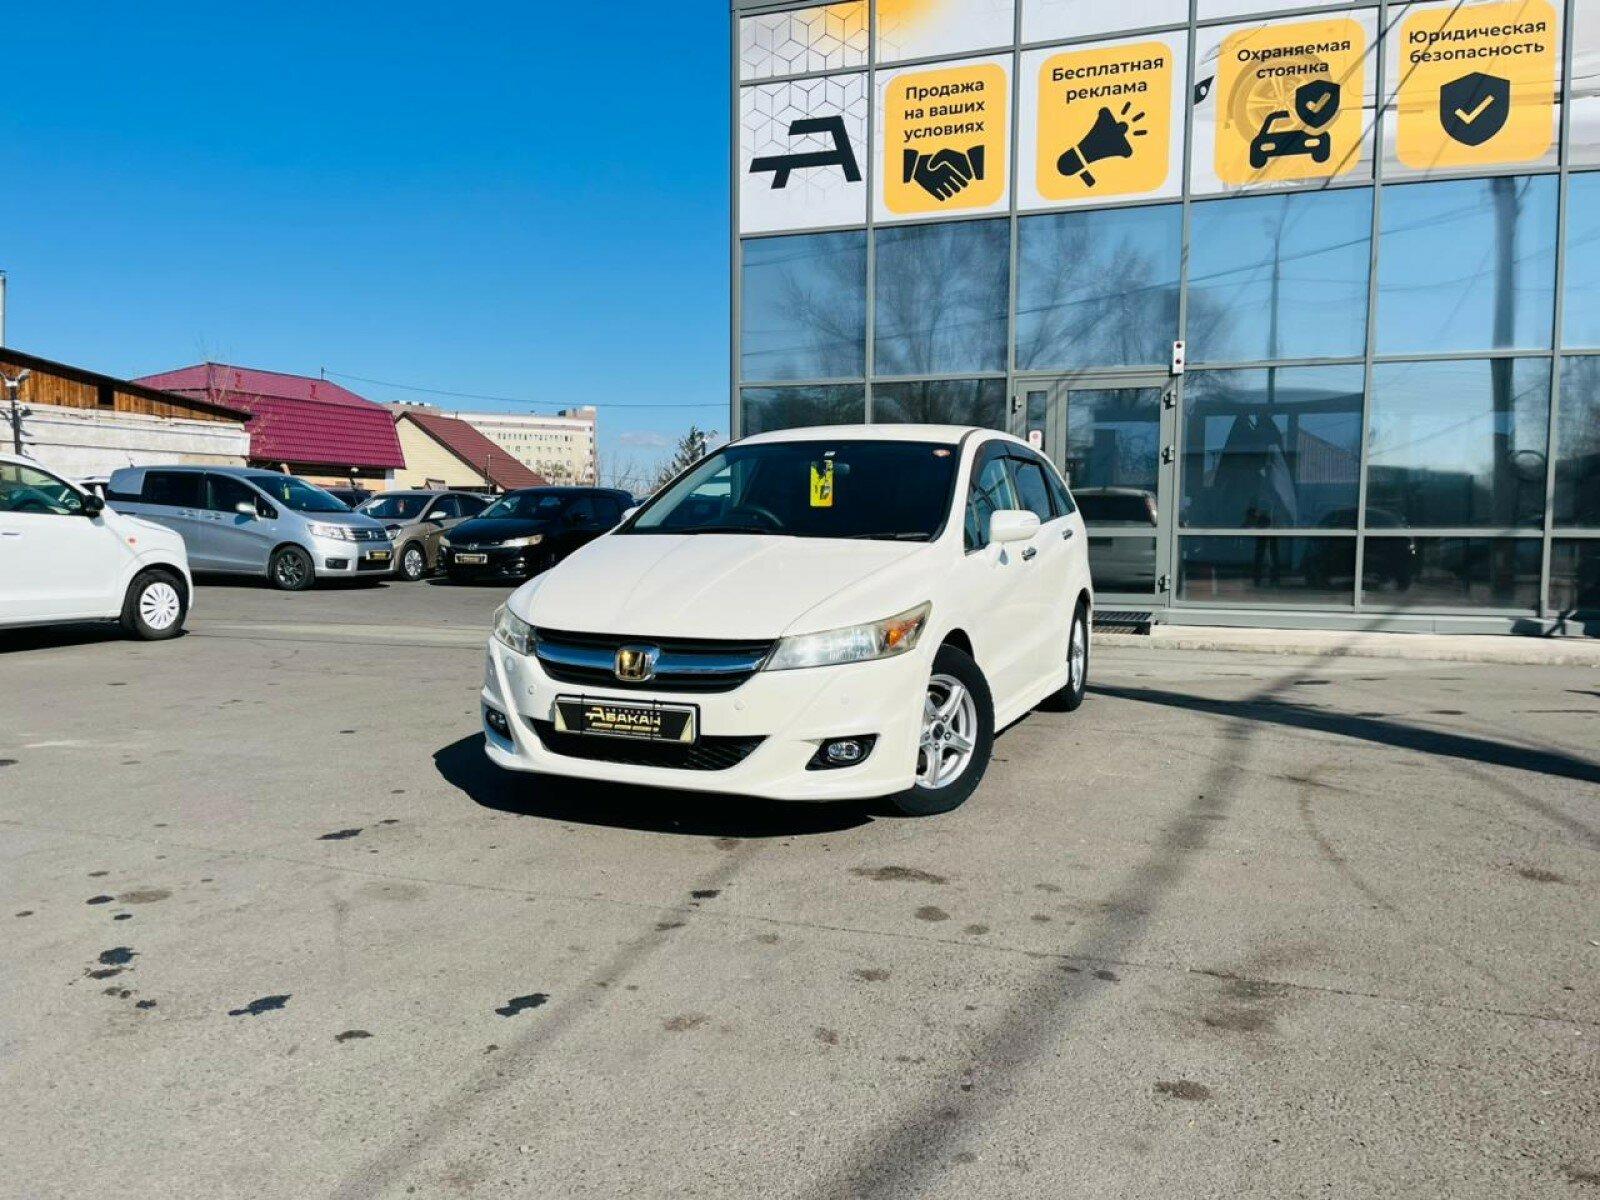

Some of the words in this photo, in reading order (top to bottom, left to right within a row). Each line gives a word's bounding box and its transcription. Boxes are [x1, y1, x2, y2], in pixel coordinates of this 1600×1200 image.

[1409, 21, 1547, 45] Юридическая
[1237, 40, 1351, 62] Охраняемая
[1410, 42, 1545, 63] безопасность
[1052, 56, 1164, 82] Бесплатная
[1256, 61, 1330, 79] стоянка
[905, 79, 985, 101] Продажа
[1066, 80, 1148, 103] реклама
[904, 107, 923, 120] на
[929, 99, 985, 118] ваших
[904, 121, 985, 142] условиях
